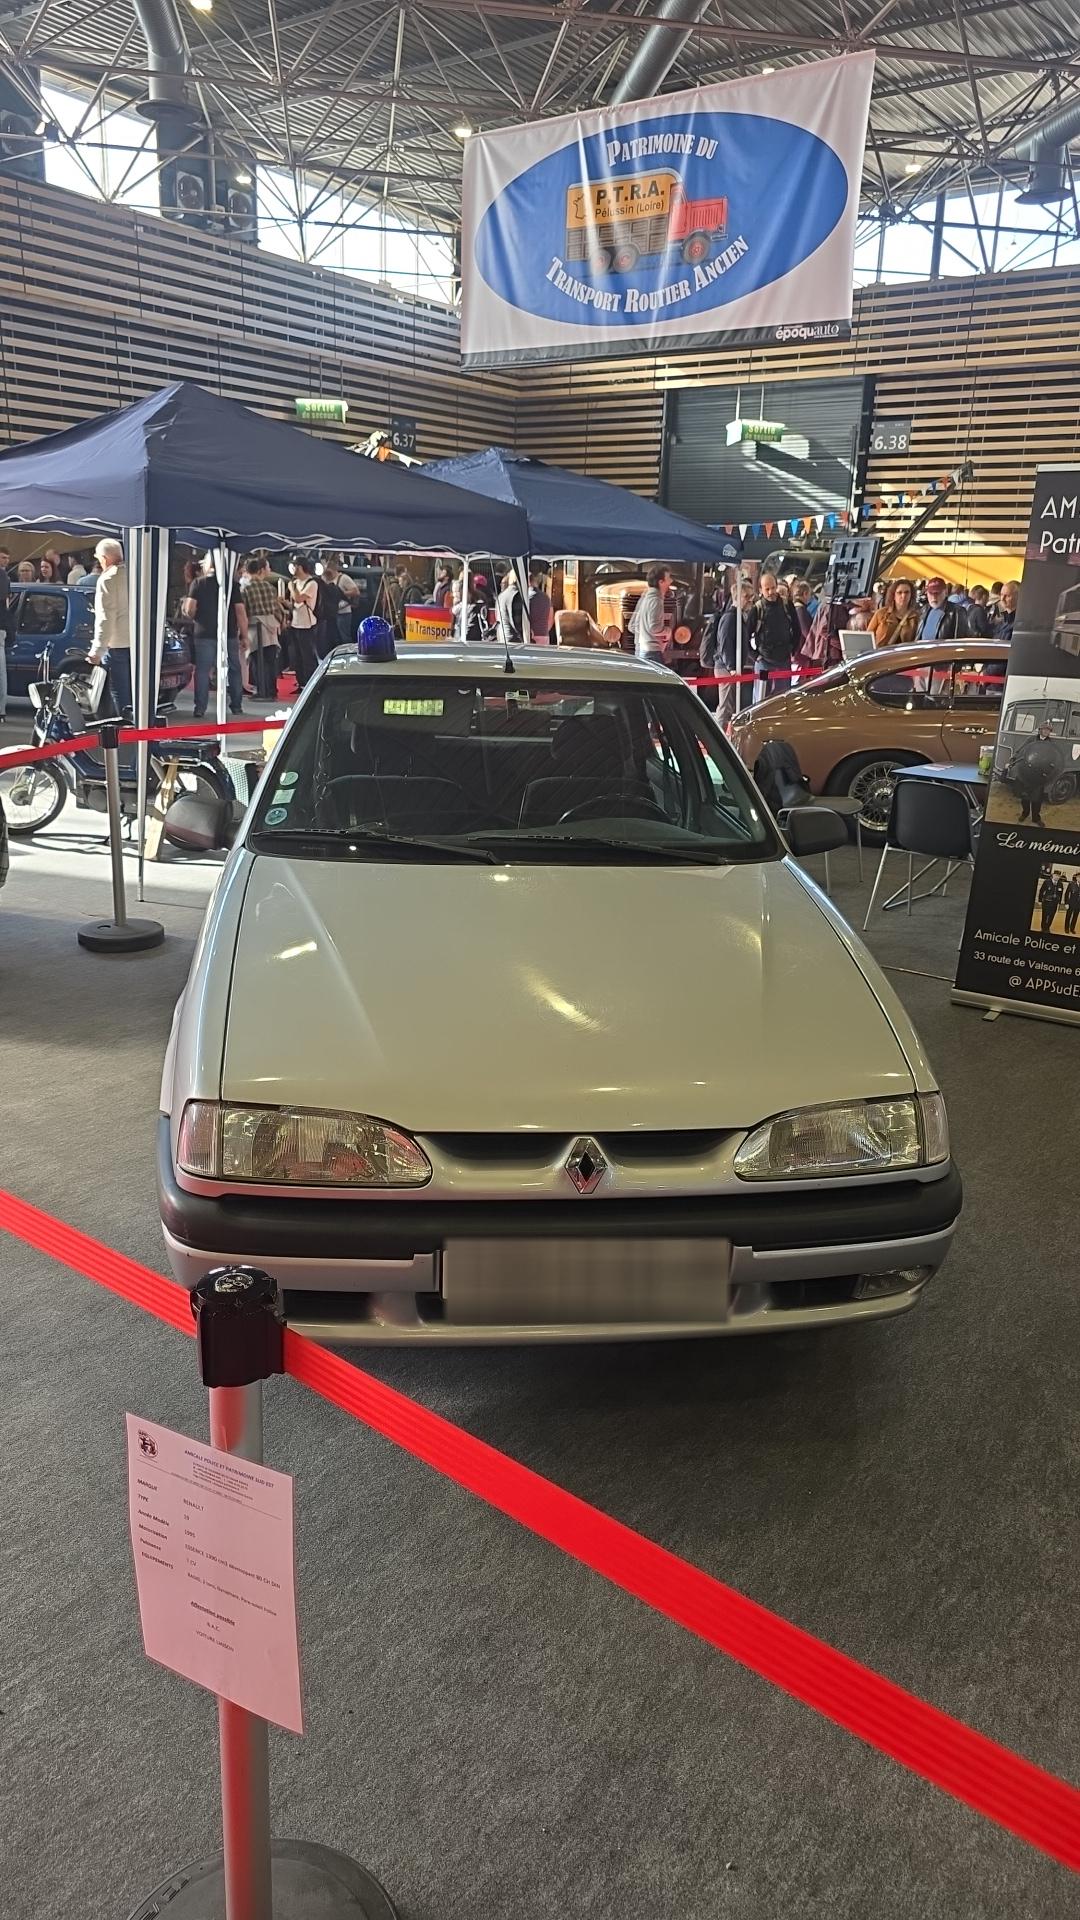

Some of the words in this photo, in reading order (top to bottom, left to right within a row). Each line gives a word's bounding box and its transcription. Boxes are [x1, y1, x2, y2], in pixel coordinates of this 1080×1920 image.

[596, 180, 665, 205] P.T.R.A.
[595, 205, 634, 218] Pélussin
[636, 199, 665, 214] (Loire)
[775, 323, 840, 342] époquauto
[305, 402, 335, 412] Sortie
[748, 425, 776, 435] Sortie
[393, 432, 415, 448] 6.37
[874, 434, 907, 450] 6.38
[1040, 495, 1080, 519] AM
[996, 831, 1028, 849] La
[974, 929, 1021, 945] Amicale
[1024, 936, 1060, 952] Police
[1063, 944, 1077, 955] et
[973, 950, 986, 960] 33
[987, 954, 1012, 965] route
[1013, 957, 1026, 967] de
[1028, 959, 1073, 975] Valsonne
[1024, 977, 1080, 998] APPSudE
[183, 1498, 204, 1512] RENAULT
